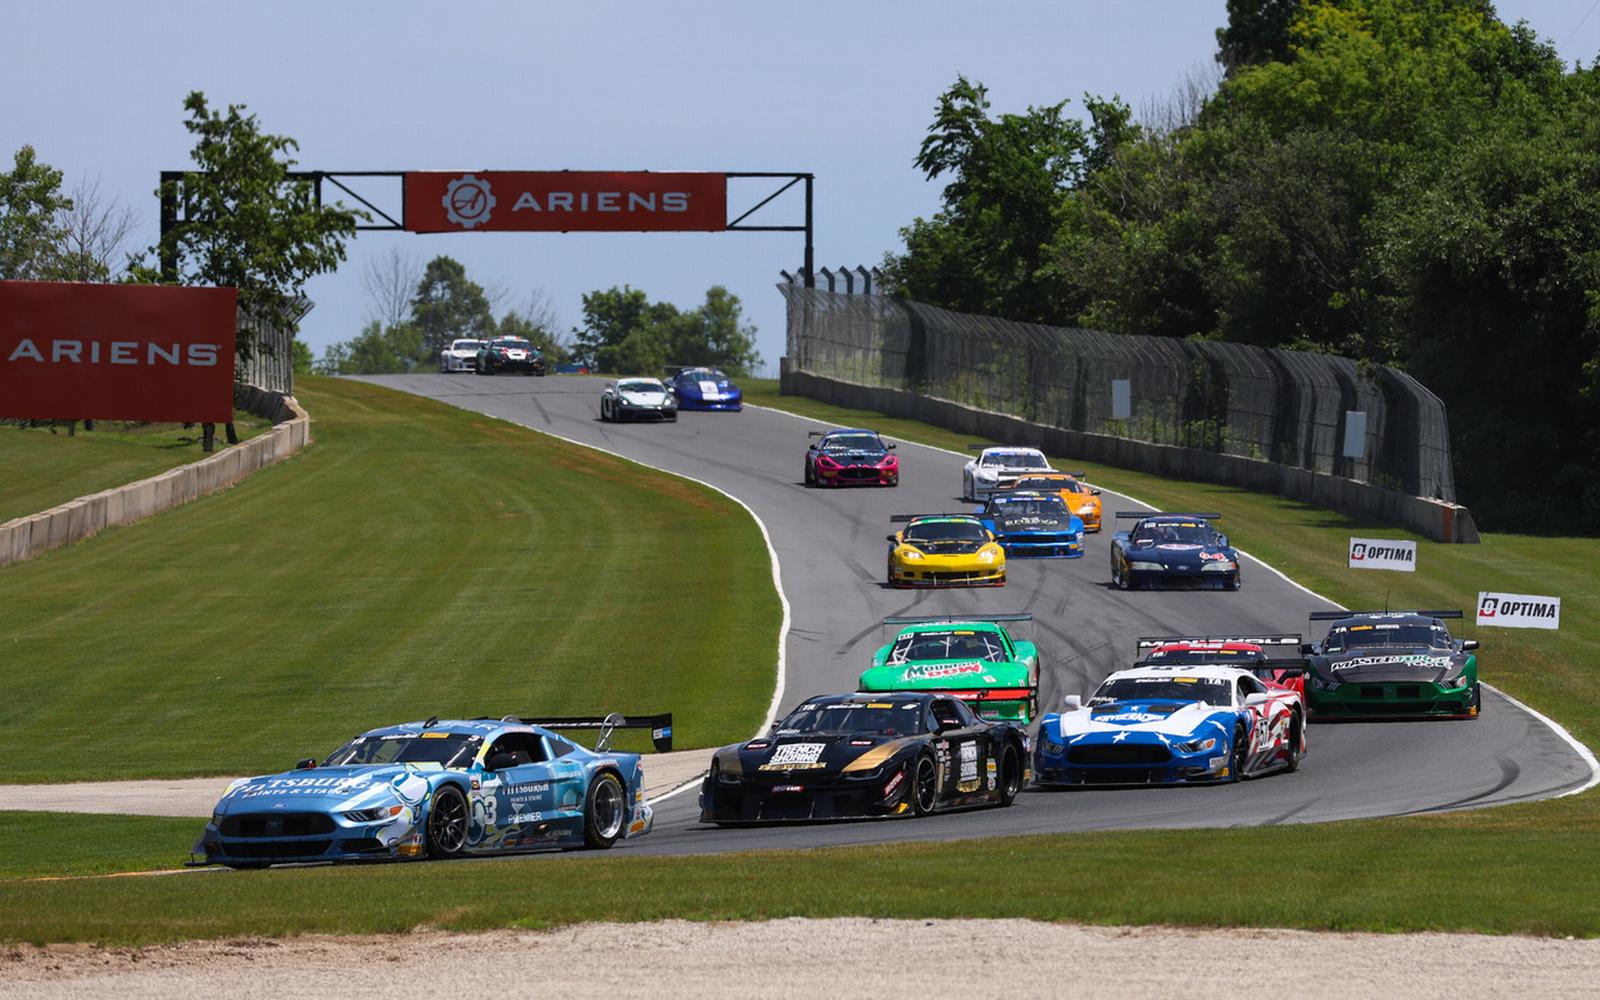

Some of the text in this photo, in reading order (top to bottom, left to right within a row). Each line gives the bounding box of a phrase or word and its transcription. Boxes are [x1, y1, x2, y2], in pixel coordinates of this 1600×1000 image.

[511, 191, 688, 212] ARIENS
[8, 338, 218, 366] ARIENS
[1367, 546, 1413, 562] OPTIMA
[1500, 601, 1556, 618] OPTIMA
[769, 752, 820, 764] SHORING
[777, 743, 826, 757] TRENCH
